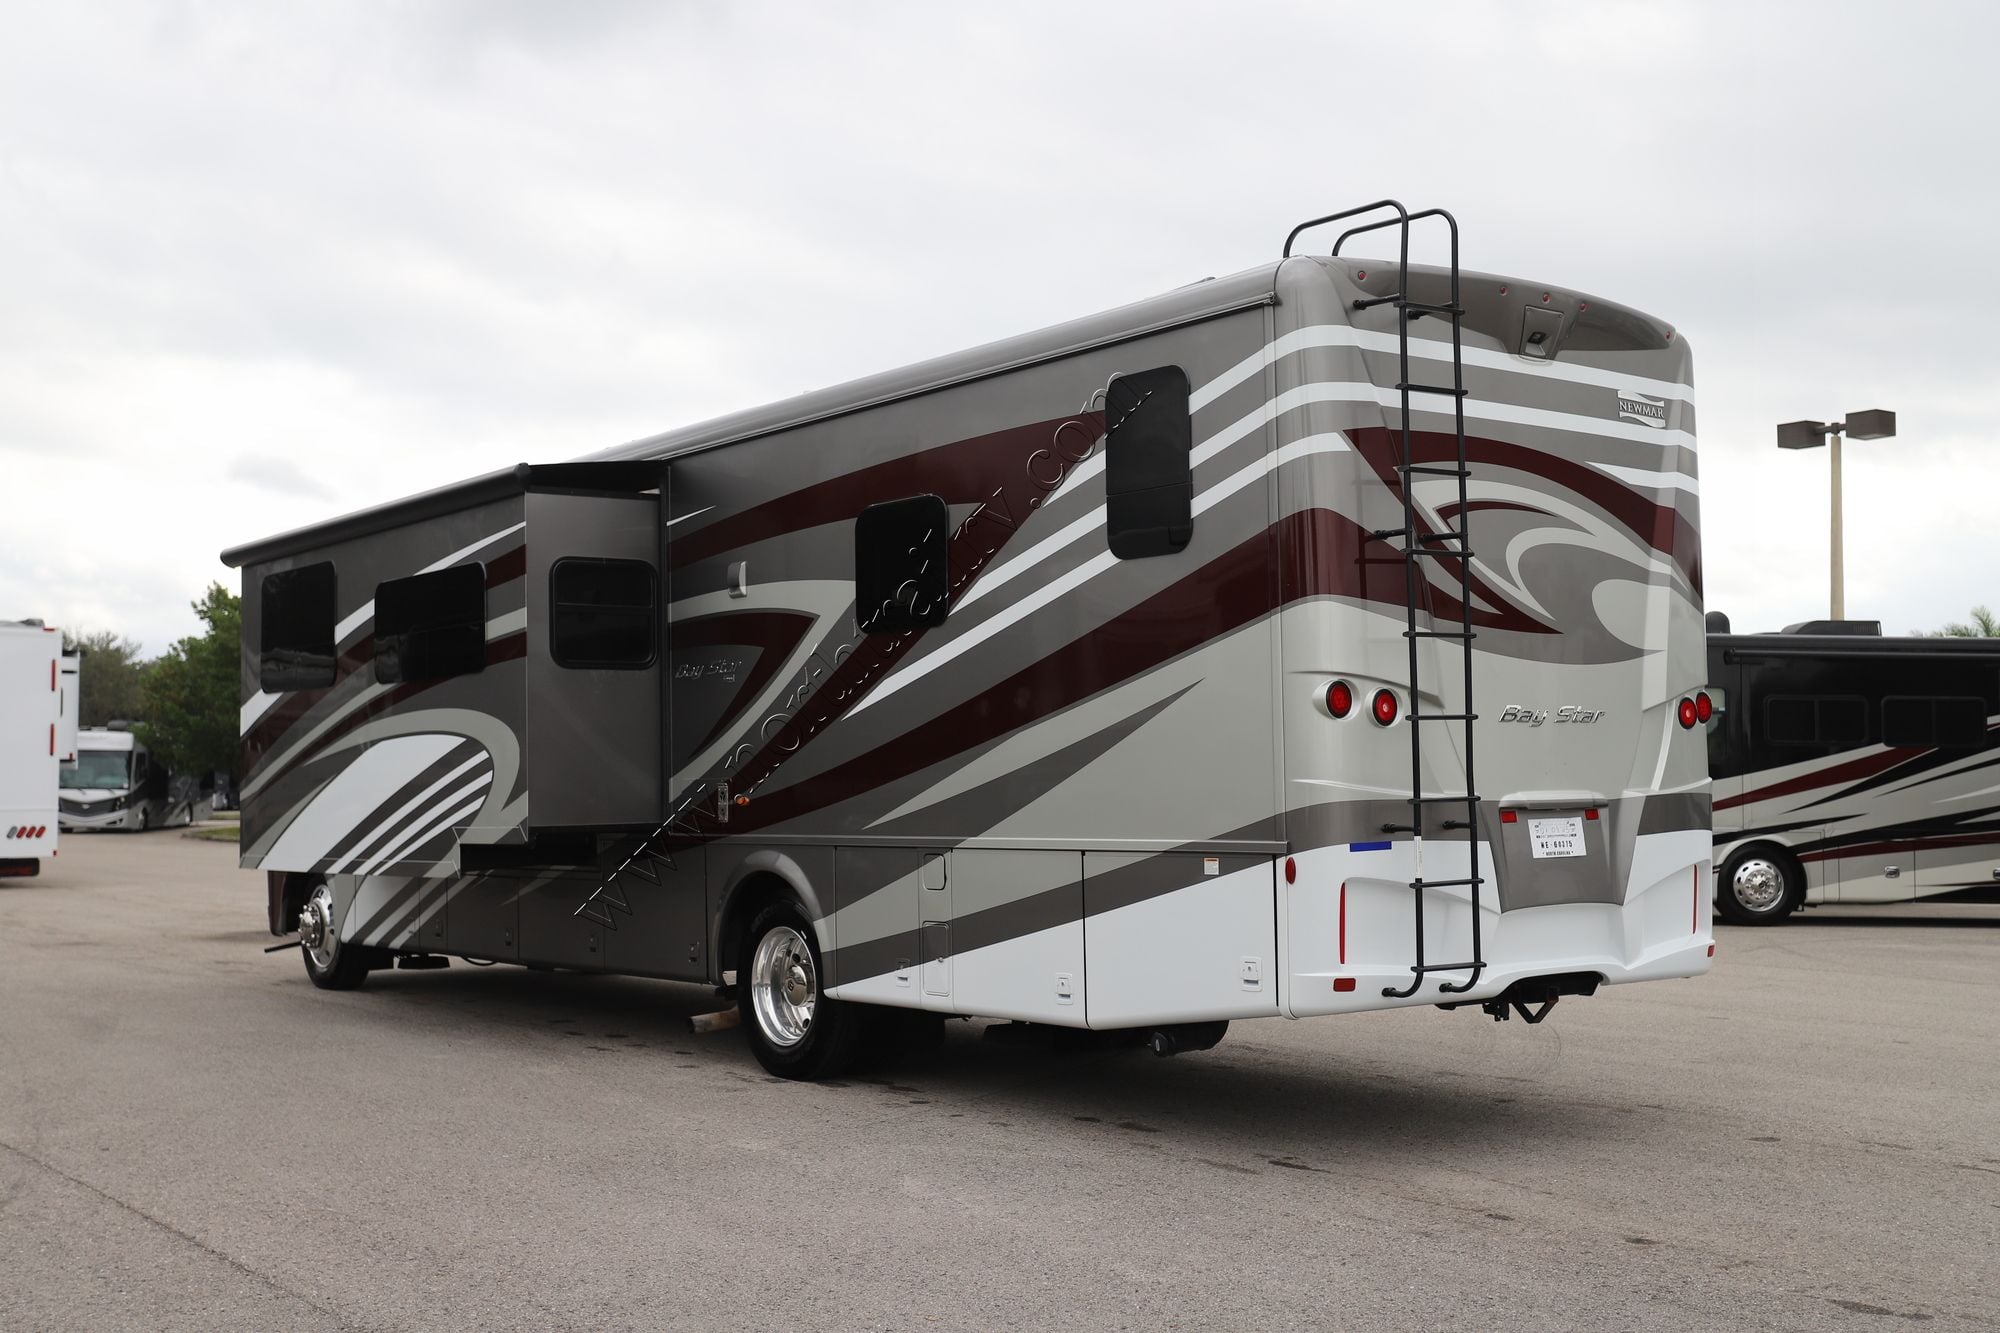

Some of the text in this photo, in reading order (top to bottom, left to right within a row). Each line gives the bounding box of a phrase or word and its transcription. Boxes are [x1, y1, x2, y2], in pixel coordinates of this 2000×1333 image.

[1619, 400, 1665, 419] NEWMAR
[1499, 704, 1606, 728] Bay Star
